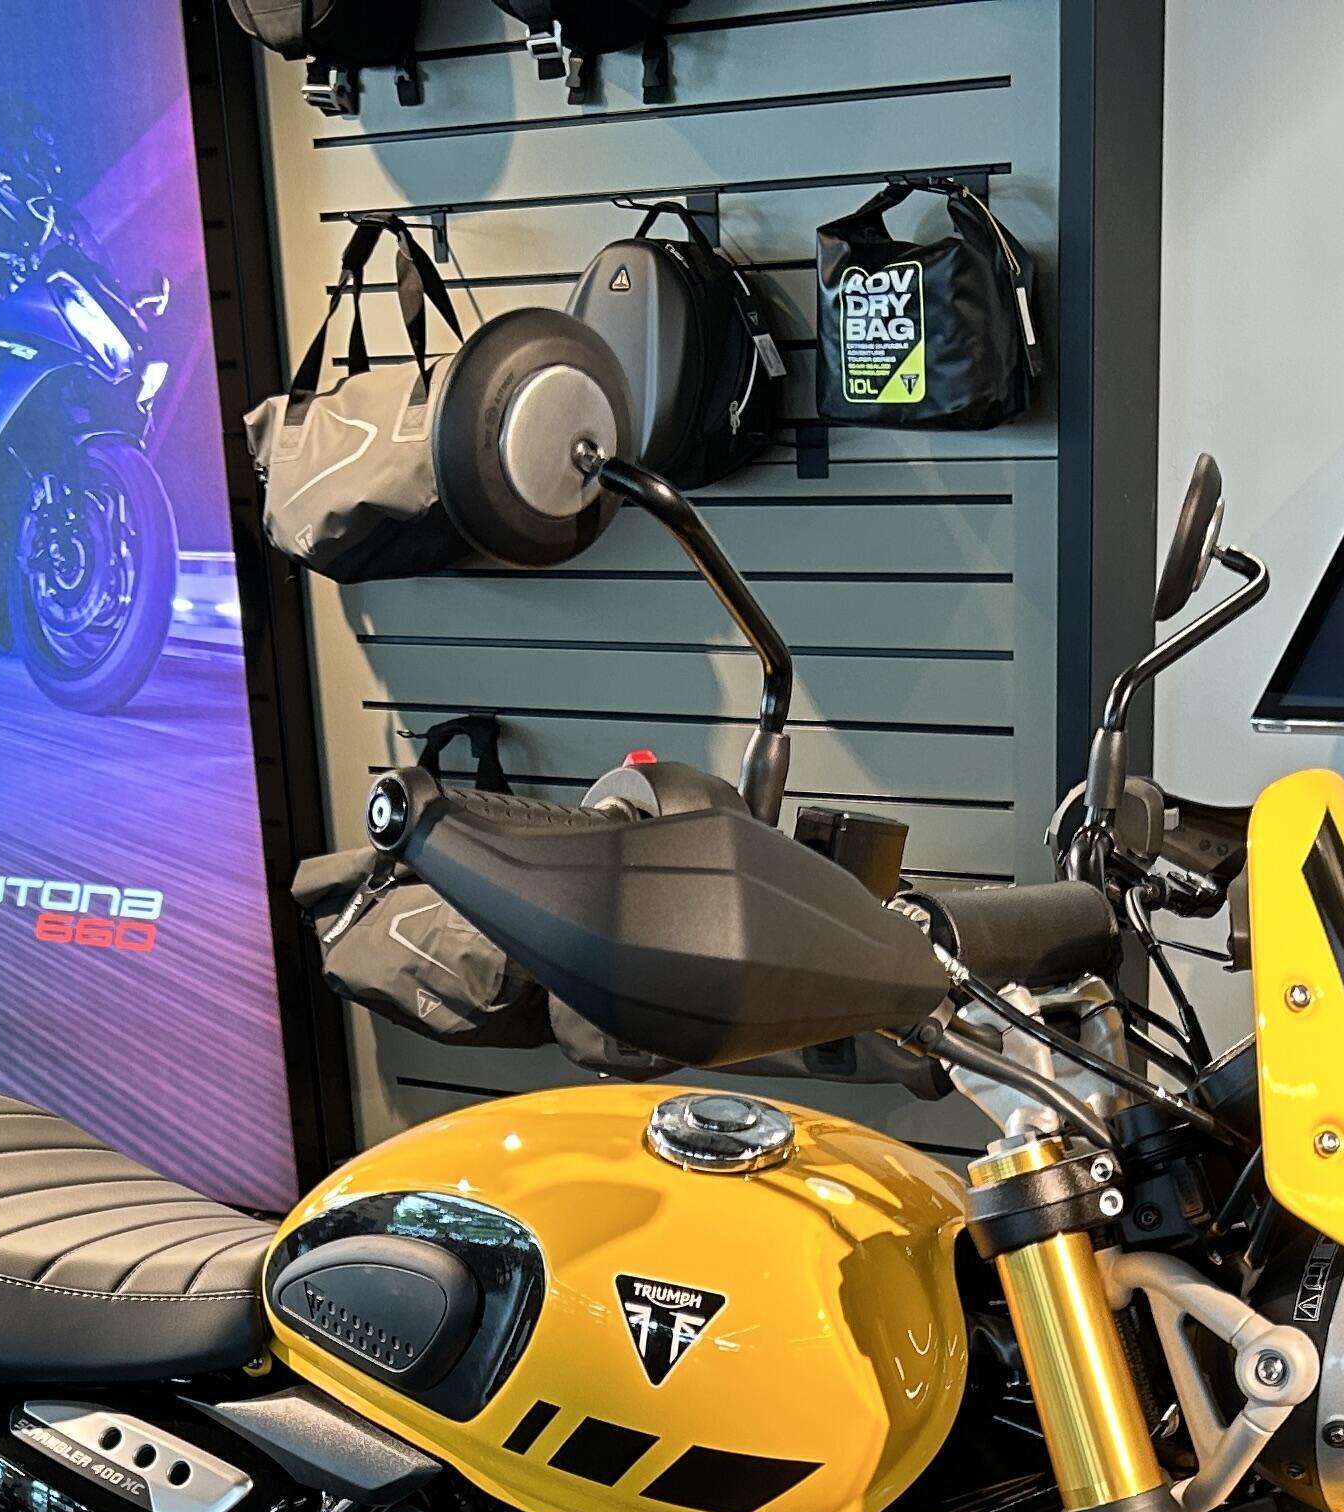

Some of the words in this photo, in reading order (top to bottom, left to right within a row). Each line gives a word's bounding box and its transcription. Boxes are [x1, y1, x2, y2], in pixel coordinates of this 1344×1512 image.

[844, 269, 915, 294] ADV
[845, 293, 912, 317] DRY
[846, 317, 915, 341] BAG
[848, 379, 878, 394] 10L
[35, 912, 157, 952] 660
[633, 1282, 703, 1309] TRIUMPH
[14, 1419, 92, 1468] SCRAMBLER
[91, 1463, 124, 1485] 400
[121, 1477, 146, 1495] XC
